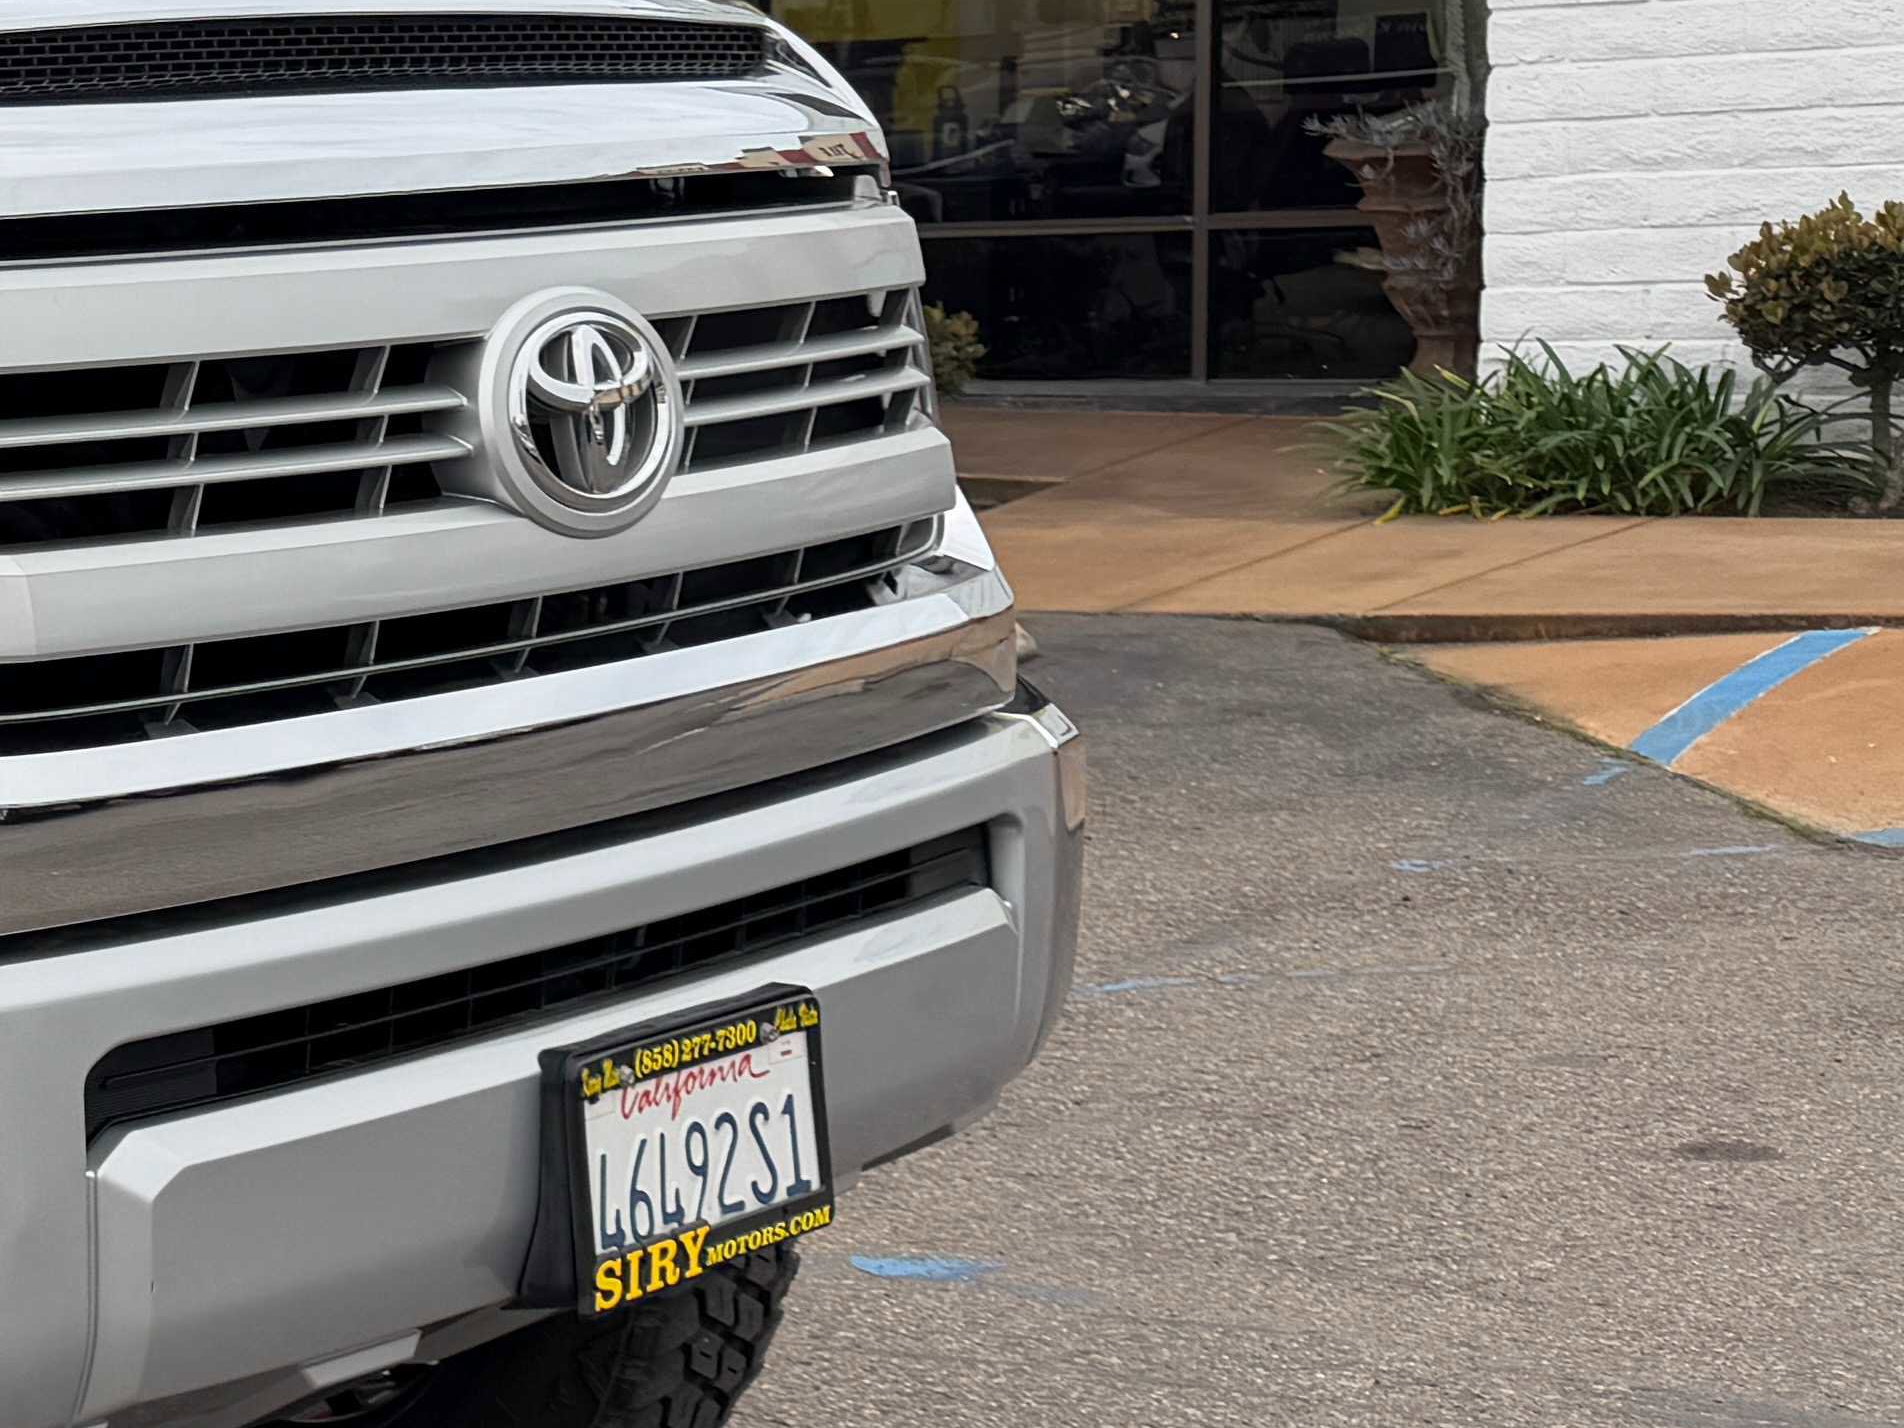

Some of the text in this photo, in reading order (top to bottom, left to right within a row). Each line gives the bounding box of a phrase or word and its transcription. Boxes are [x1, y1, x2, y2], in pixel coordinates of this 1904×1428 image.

[620, 1054, 769, 1120] California
[634, 1040, 679, 1078] (858)
[600, 1093, 812, 1250] 46492S1
[594, 1224, 711, 1312] SIRY
[705, 1205, 832, 1266] MOTORS.COM
